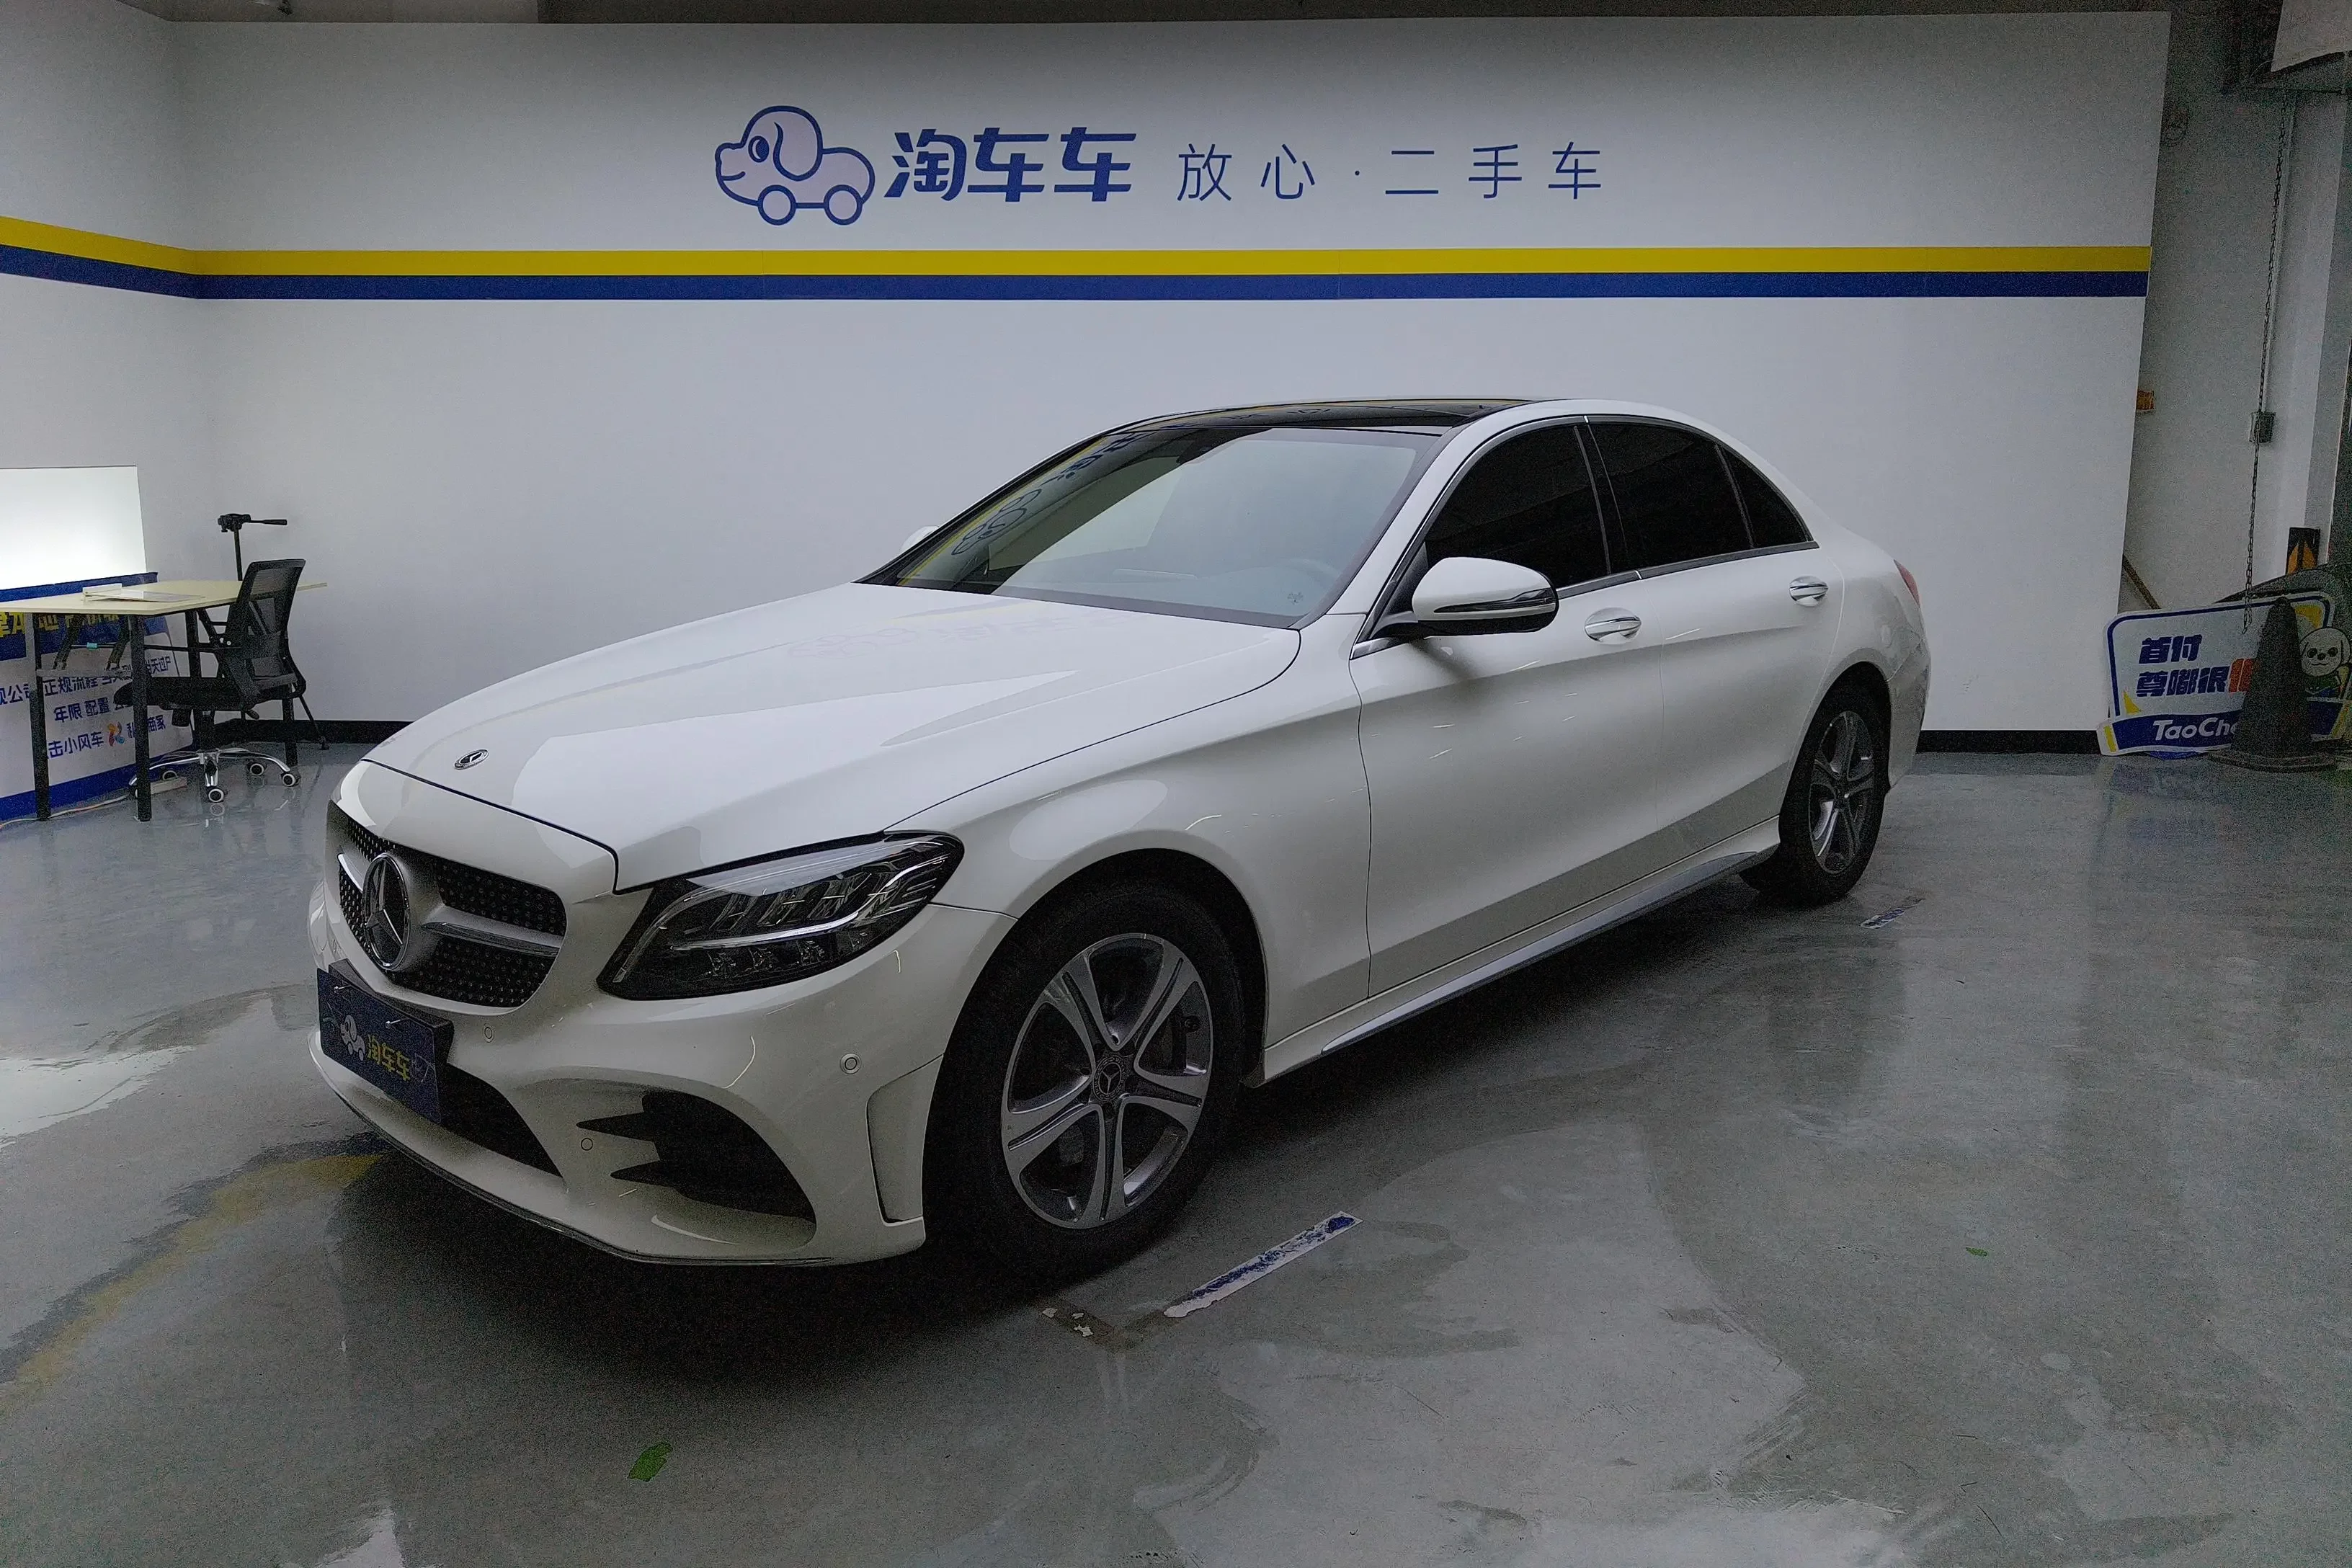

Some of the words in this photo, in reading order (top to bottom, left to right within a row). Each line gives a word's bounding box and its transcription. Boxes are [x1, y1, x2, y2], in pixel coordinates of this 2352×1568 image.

[883, 127, 1136, 202] 淘车车
[2138, 634, 2202, 664] 首付
[53, 703, 83, 723] 年限
[47, 731, 104, 759] 击小风车
[368, 1033, 411, 1081] 淘车车
